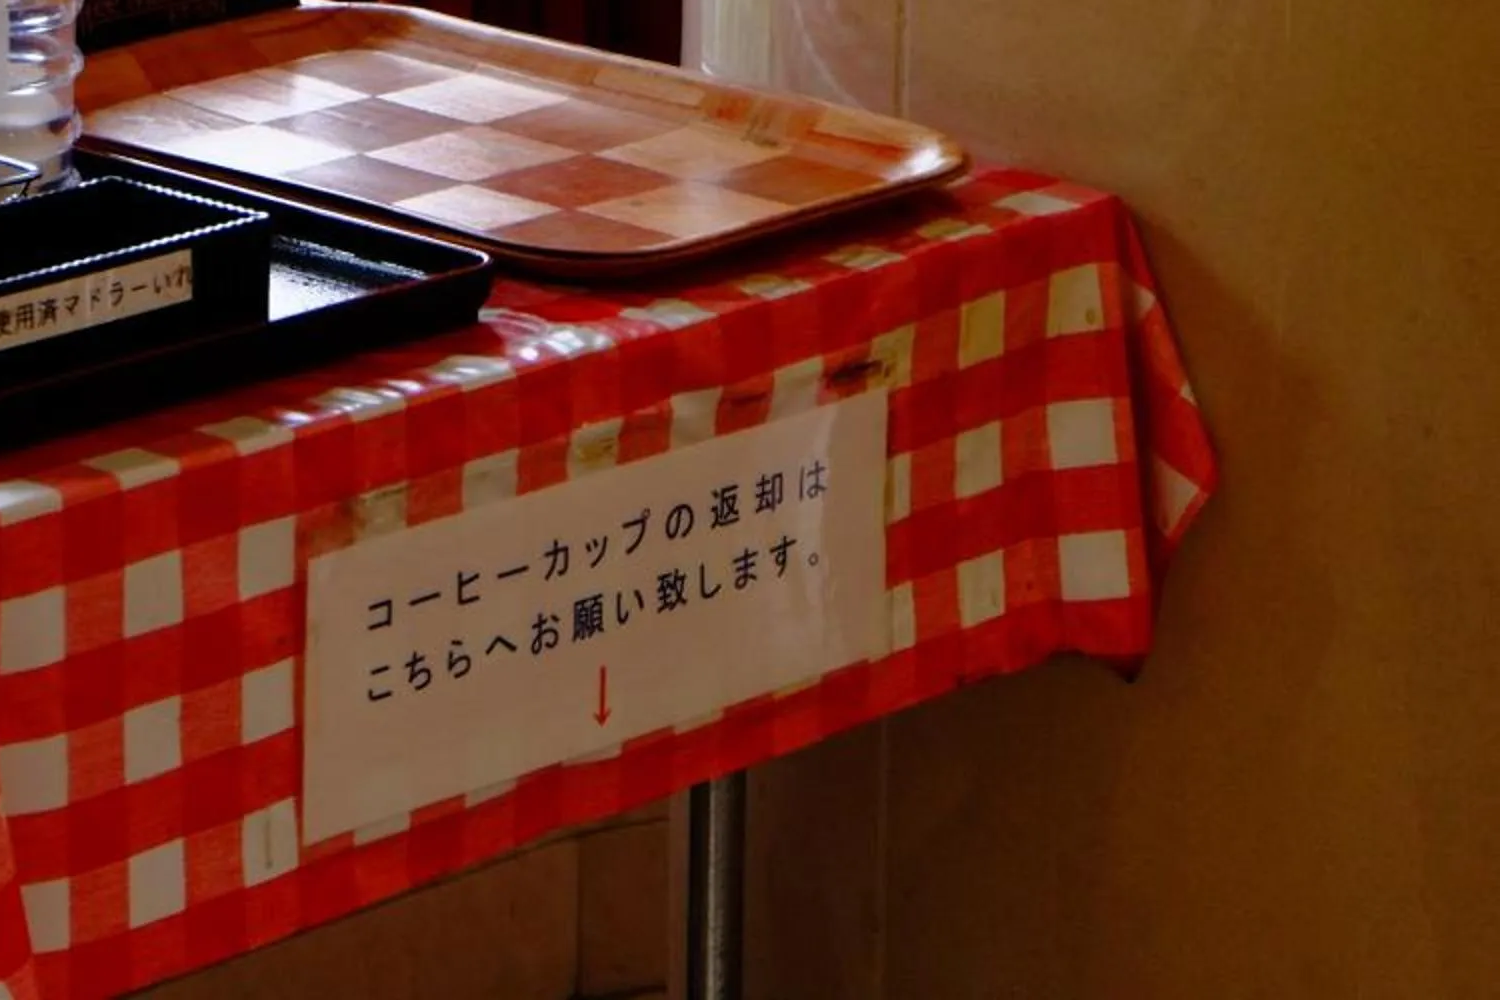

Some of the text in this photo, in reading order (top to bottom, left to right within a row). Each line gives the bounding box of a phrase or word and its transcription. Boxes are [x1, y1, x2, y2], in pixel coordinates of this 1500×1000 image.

[367, 460, 828, 631] コーヒーカップの返却は
[367, 536, 820, 702] こちらへお願い致します。
